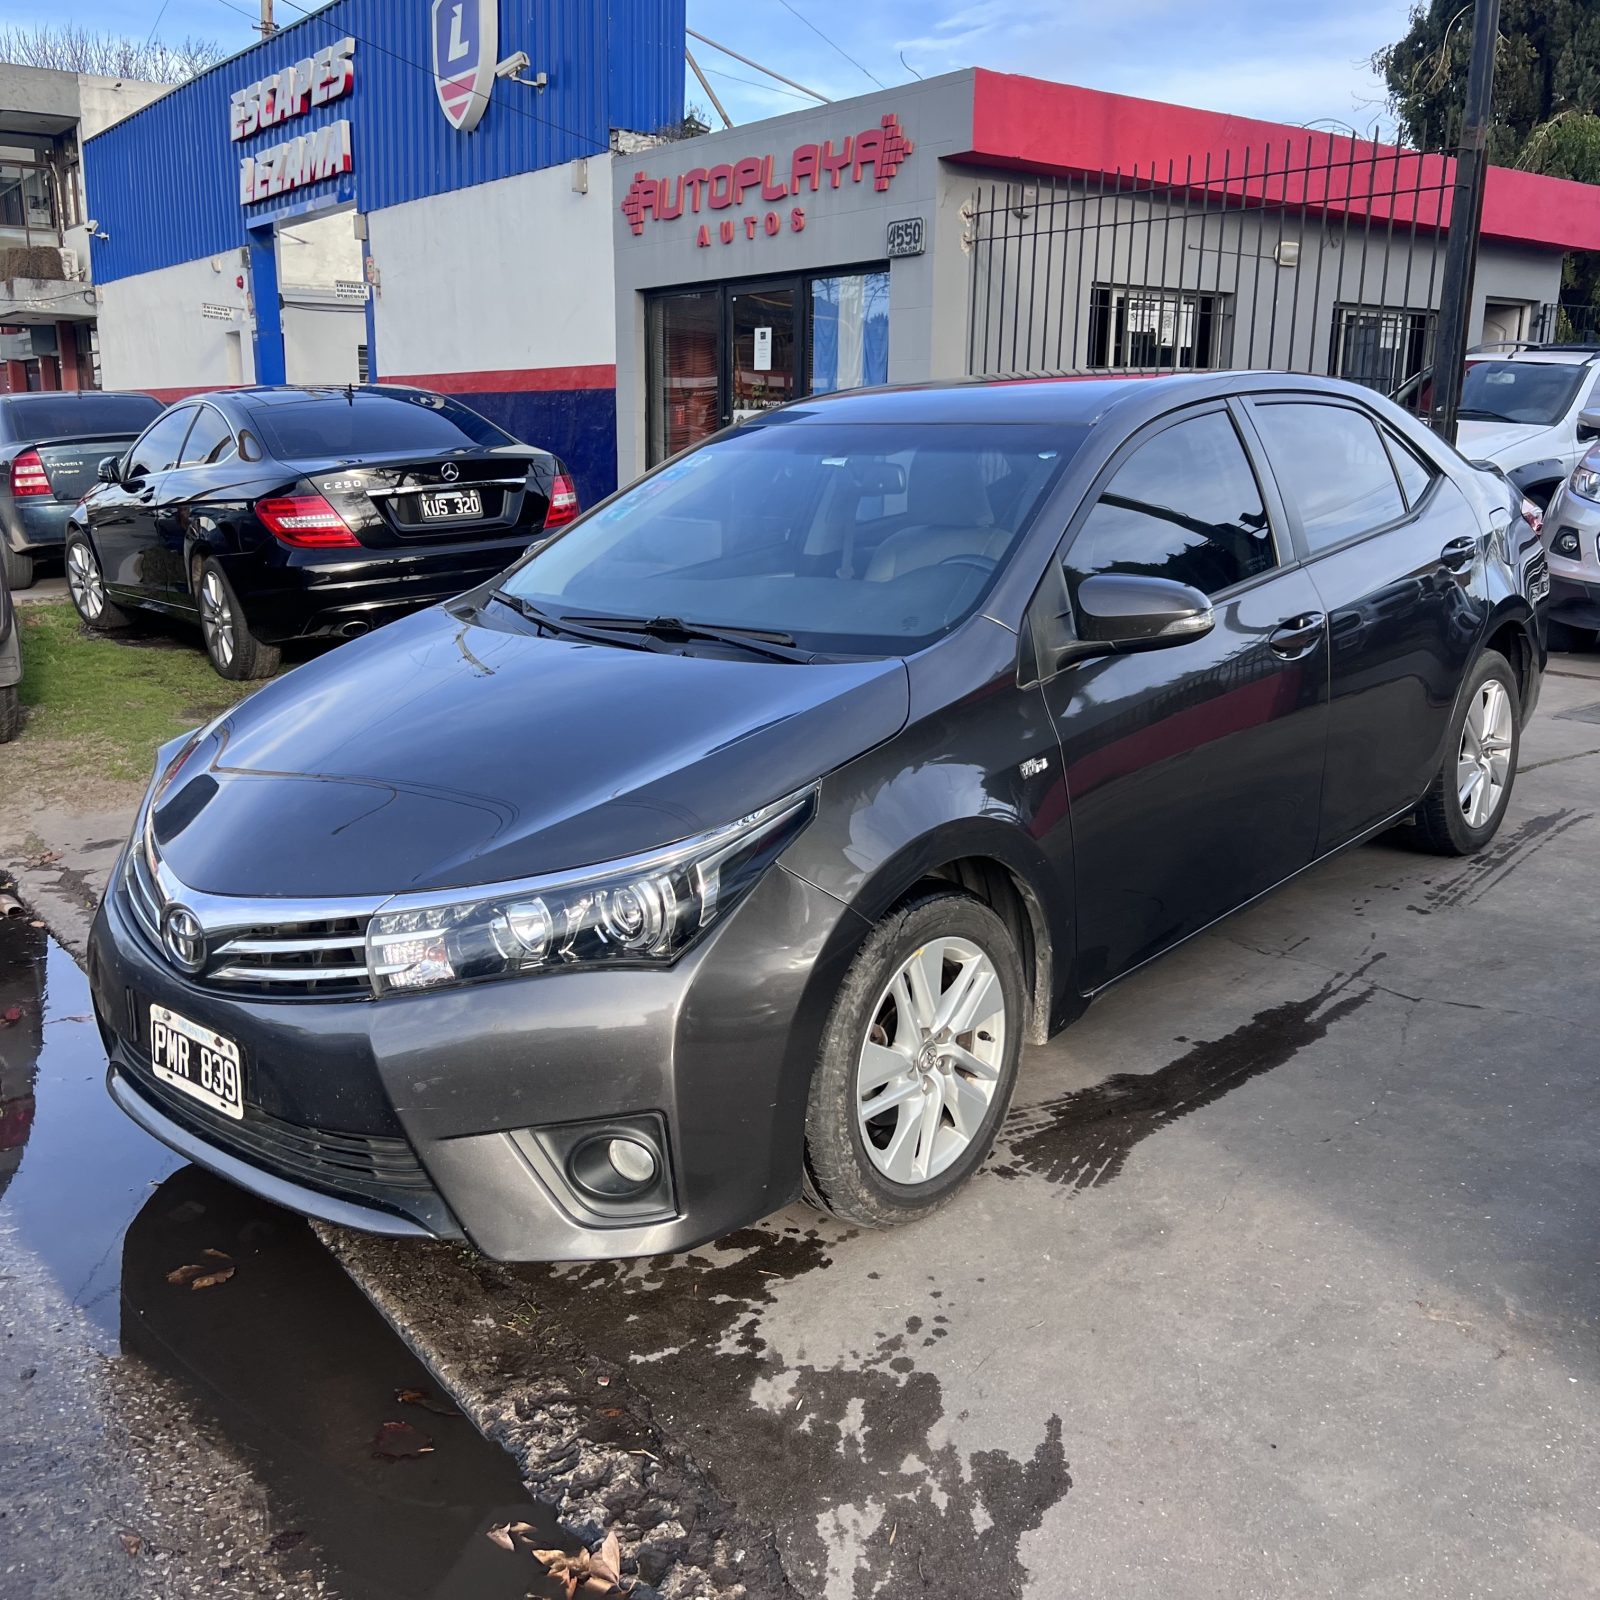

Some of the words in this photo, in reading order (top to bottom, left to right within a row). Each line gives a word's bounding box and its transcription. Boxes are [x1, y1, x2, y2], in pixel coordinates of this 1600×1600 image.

[230, 36, 356, 142] ESCAPES
[240, 119, 352, 206] LEZAMA
[636, 128, 886, 221] AUTOPLAYA
[697, 207, 805, 248] AUTOS
[889, 222, 921, 249] 4550
[323, 482, 331, 490] C
[334, 480, 362, 489] 250
[423, 499, 449, 517] KUS
[455, 496, 480, 514] 320
[154, 1023, 190, 1078] PMR
[200, 1047, 237, 1102] 839
